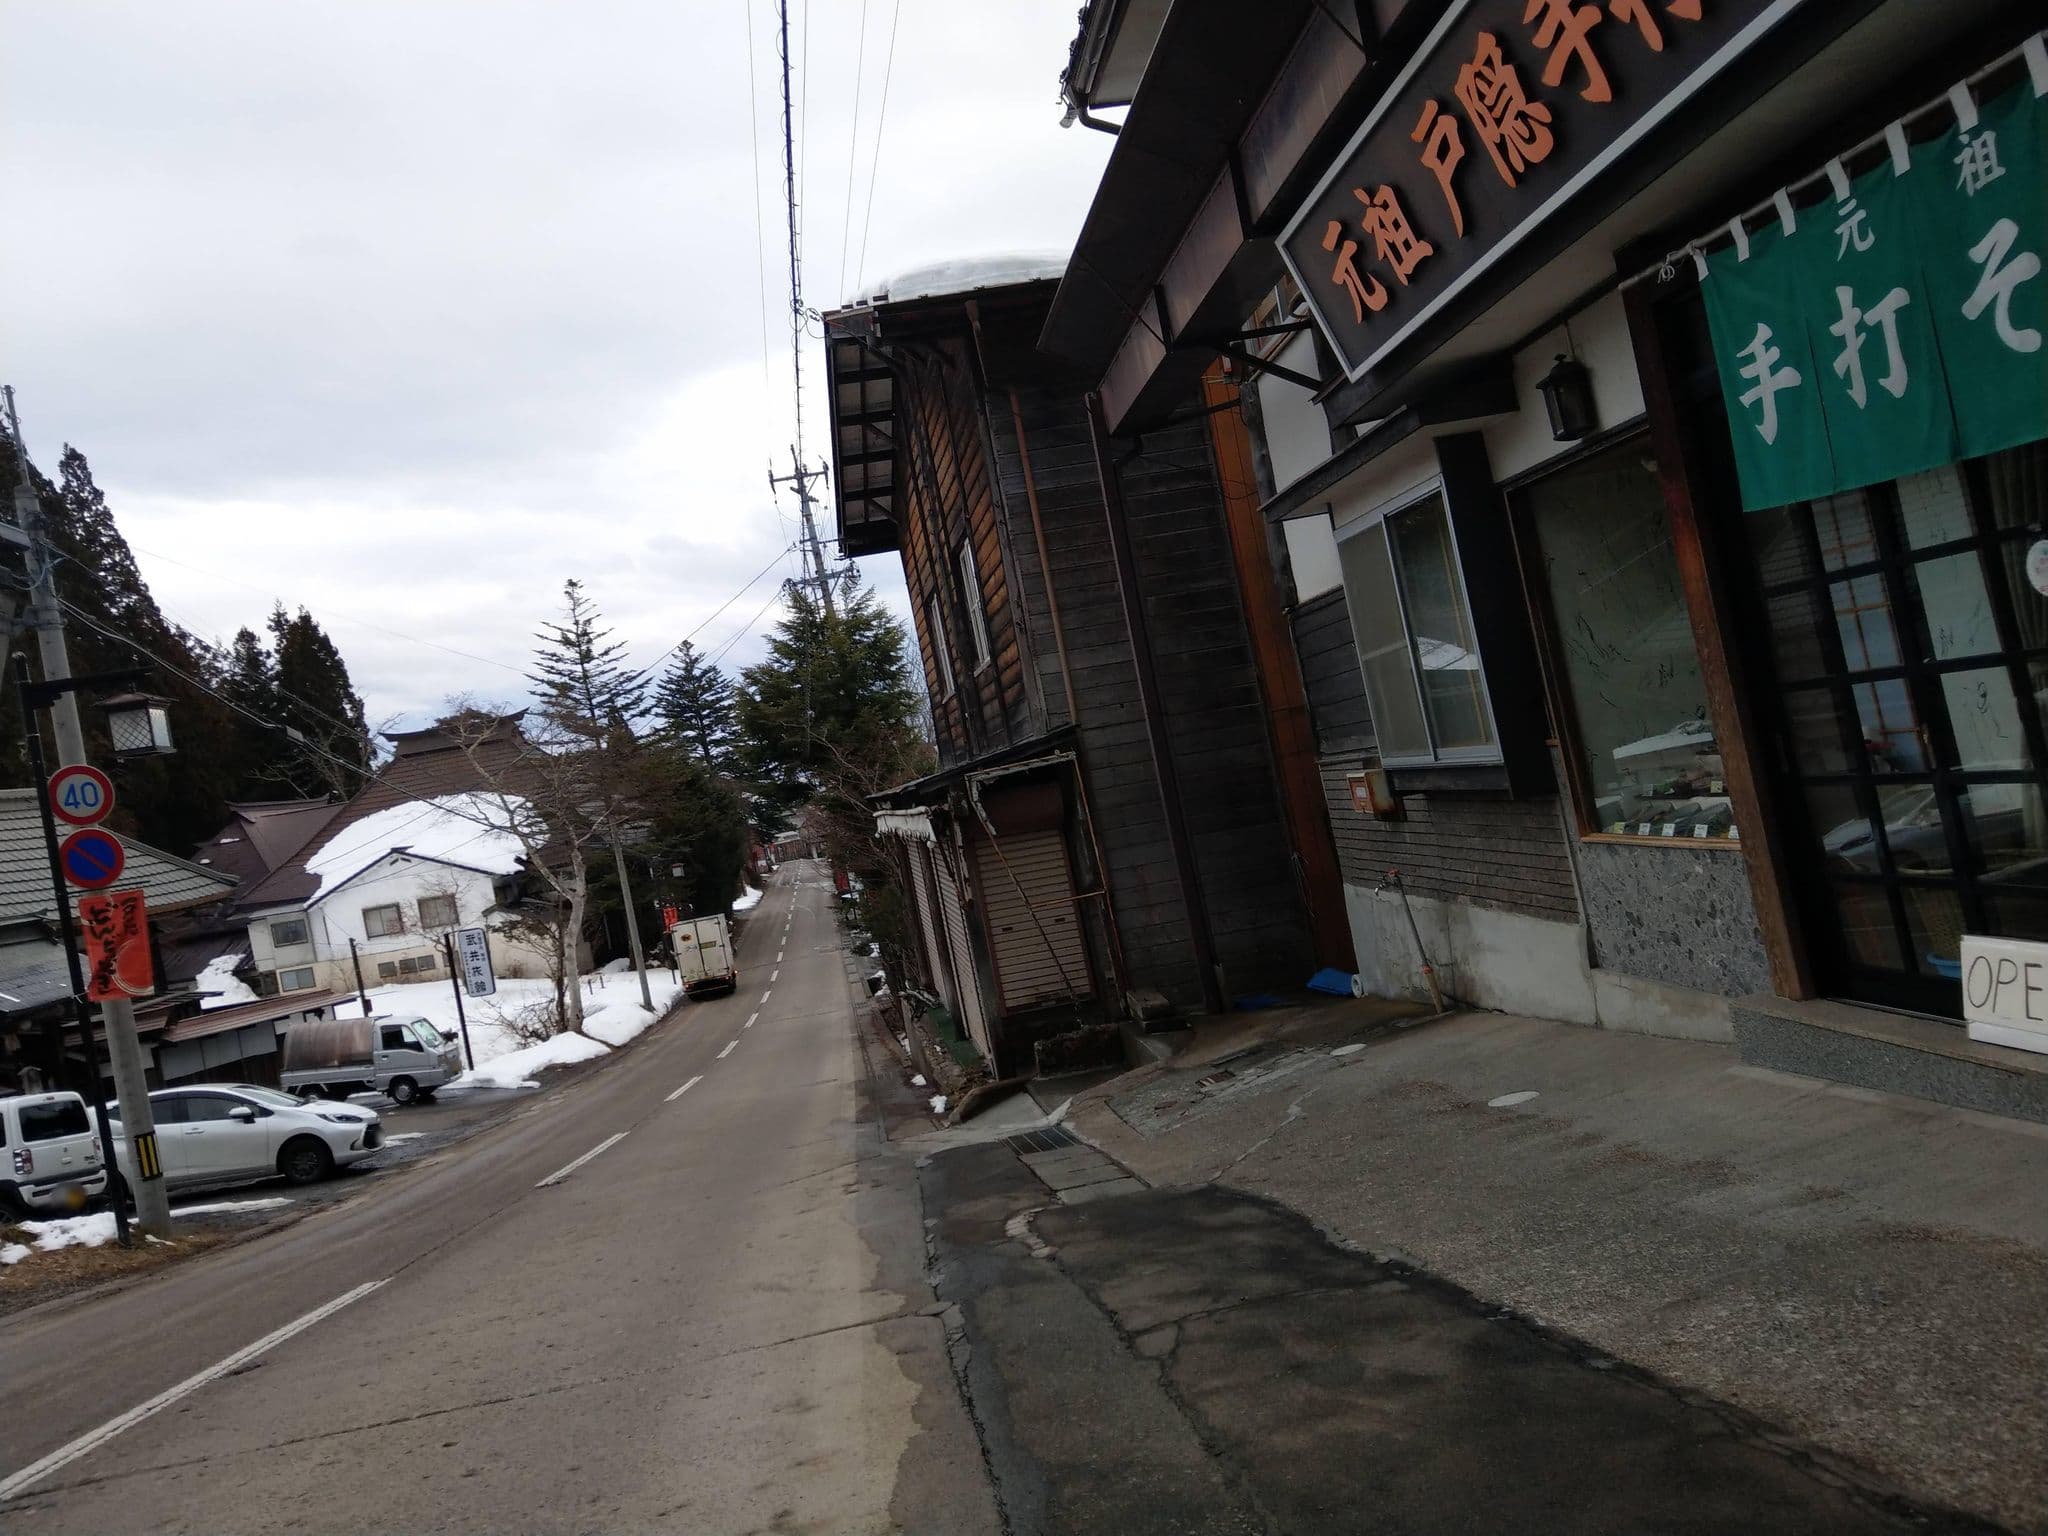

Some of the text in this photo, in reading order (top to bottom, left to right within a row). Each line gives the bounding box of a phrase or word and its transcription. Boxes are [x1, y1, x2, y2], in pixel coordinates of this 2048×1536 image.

[1322, 0, 1701, 324] 元祖戸隠手
[1834, 130, 2006, 262] 元祖
[1735, 217, 2042, 446] 手打そ
[63, 781, 99, 809] 40
[1967, 955, 2044, 1021] OPE
